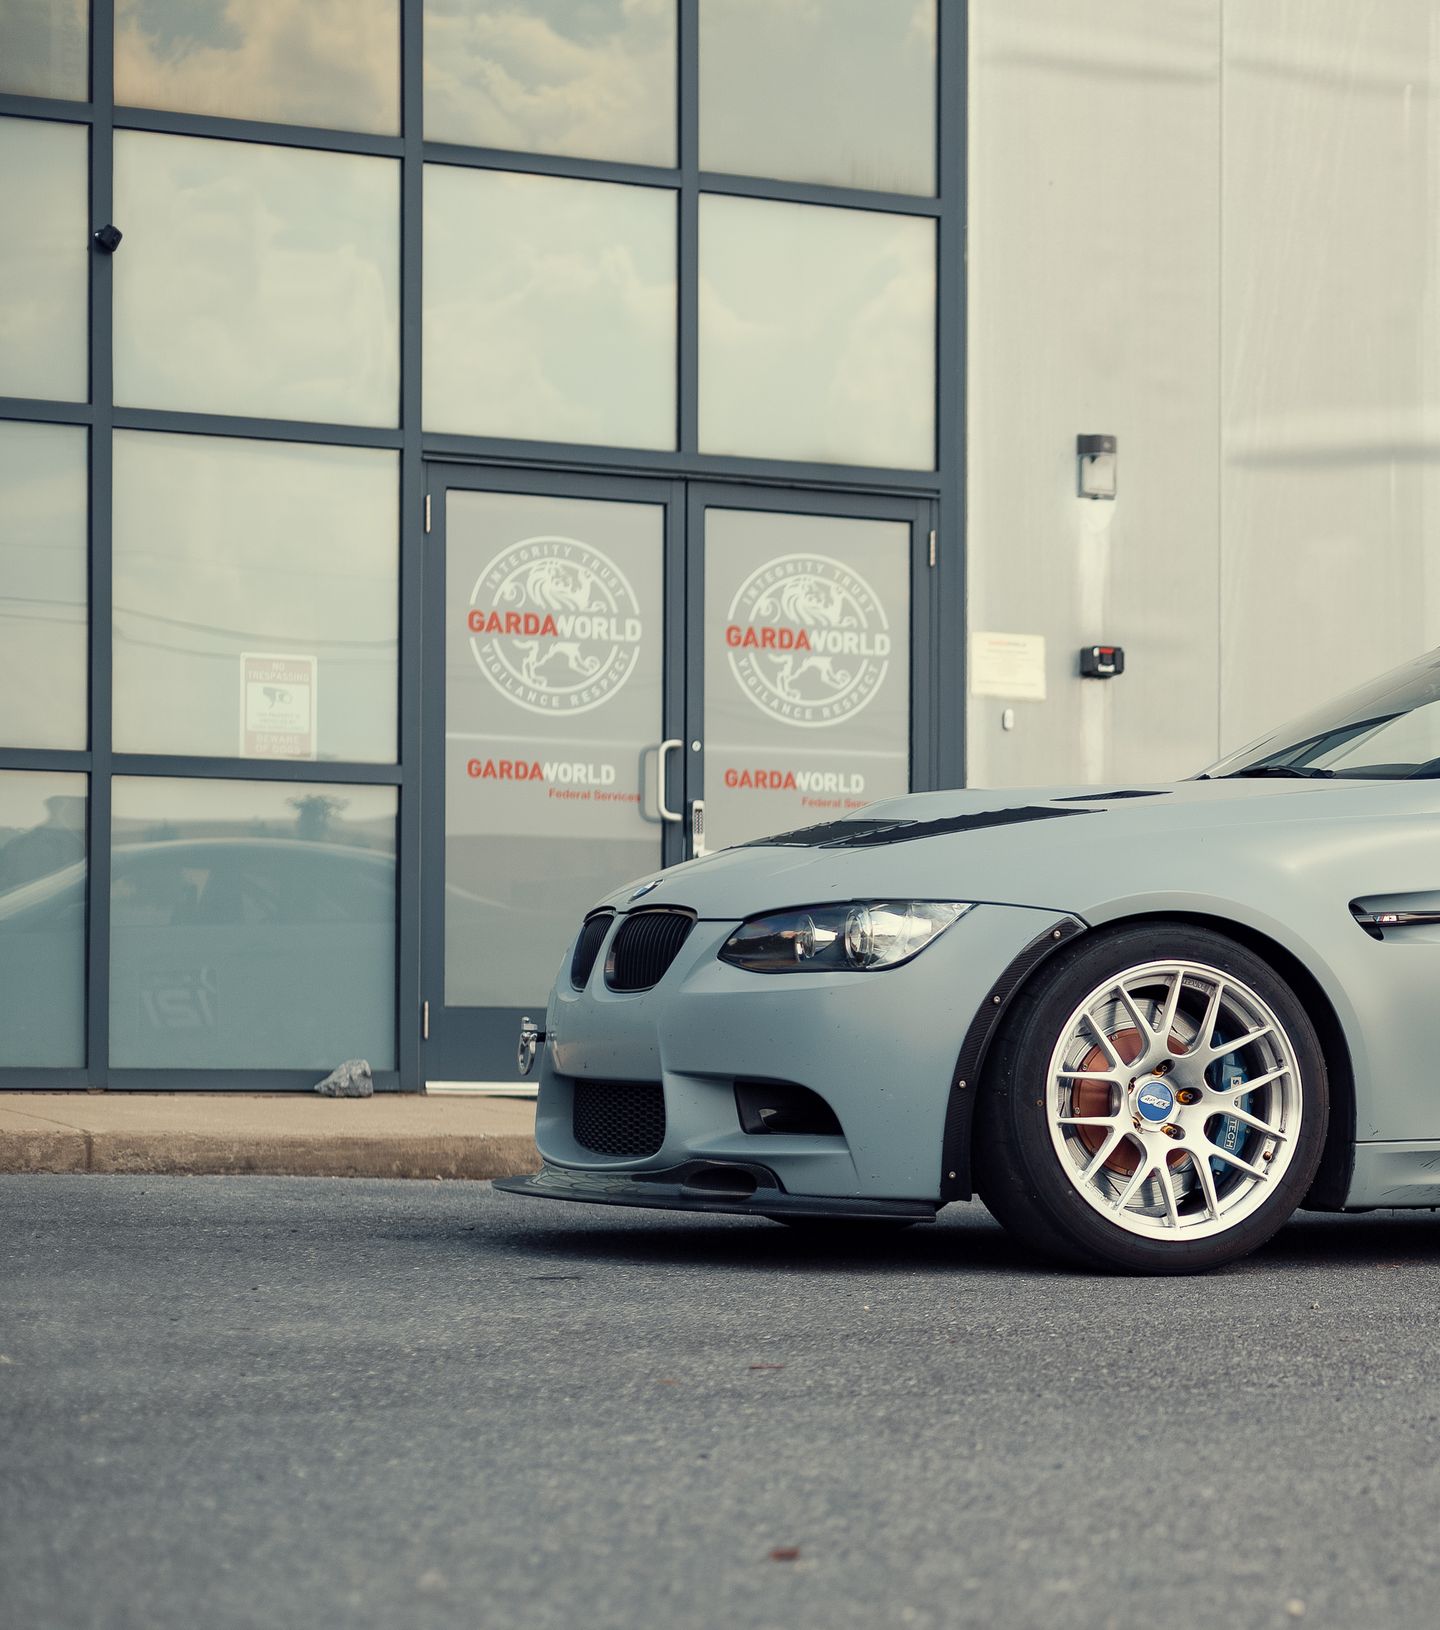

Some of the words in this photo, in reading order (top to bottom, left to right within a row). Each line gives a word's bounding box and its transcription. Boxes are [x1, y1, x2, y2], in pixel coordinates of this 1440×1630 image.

[486, 543, 572, 589] INTEGRITY
[581, 553, 626, 598] TRUST
[742, 561, 824, 605] INTEGRITY
[833, 570, 875, 613] TRUST
[467, 609, 642, 642] GARDAWORLD
[725, 625, 891, 657] GARDAWORLD
[248, 671, 309, 682] TRESPASSING
[272, 661, 285, 672] NO
[481, 643, 560, 708] VIGILANCE
[570, 650, 630, 707] RESPECT
[738, 657, 813, 720] VIGILANCE
[822, 665, 879, 718] RESPECT
[255, 743, 268, 753] OF
[271, 744, 301, 755] DOGS
[256, 734, 300, 745] BEWARE
[467, 758, 616, 785] GARDAWORLD
[724, 768, 865, 794] GARDAWORLD
[548, 788, 591, 800] Federal
[801, 797, 841, 808] Federal
